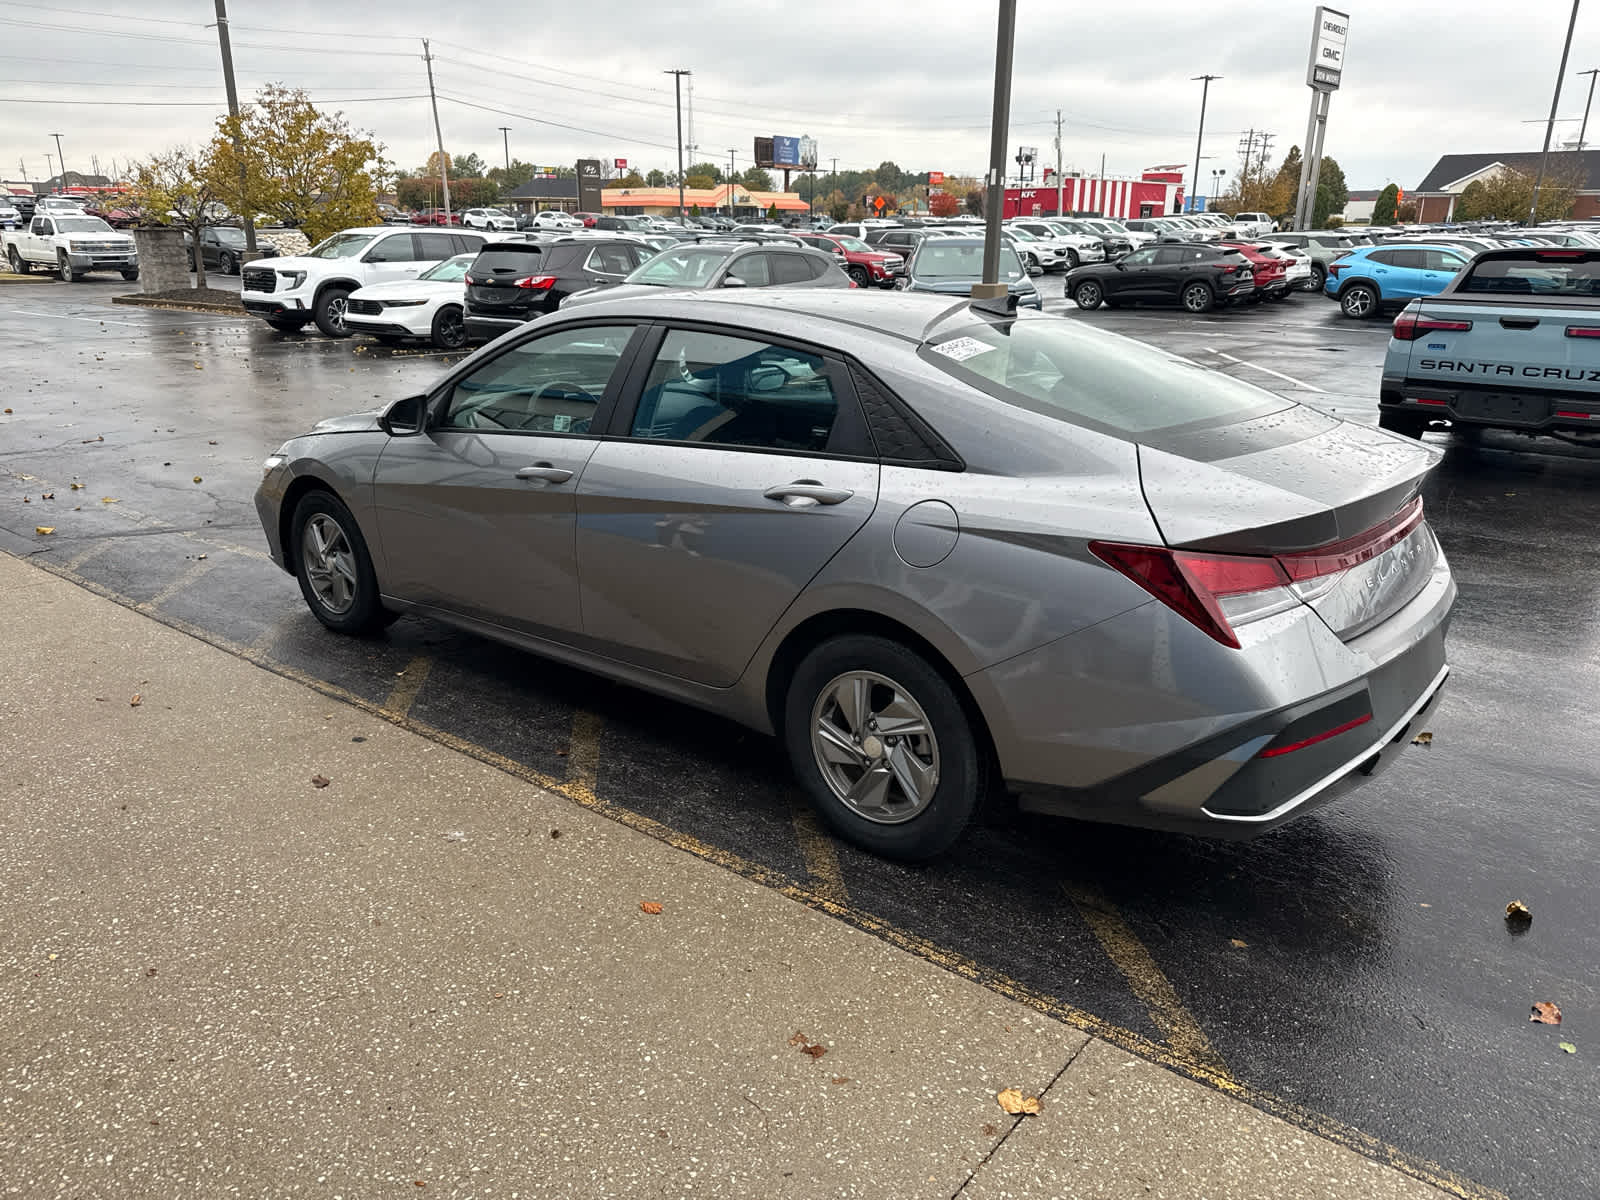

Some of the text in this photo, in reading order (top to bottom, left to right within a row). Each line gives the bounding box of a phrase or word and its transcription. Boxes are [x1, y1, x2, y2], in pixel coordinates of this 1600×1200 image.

[1322, 47, 1340, 61] GMC
[1021, 191, 1037, 199] KFC
[1420, 359, 1514, 376] SANTA
